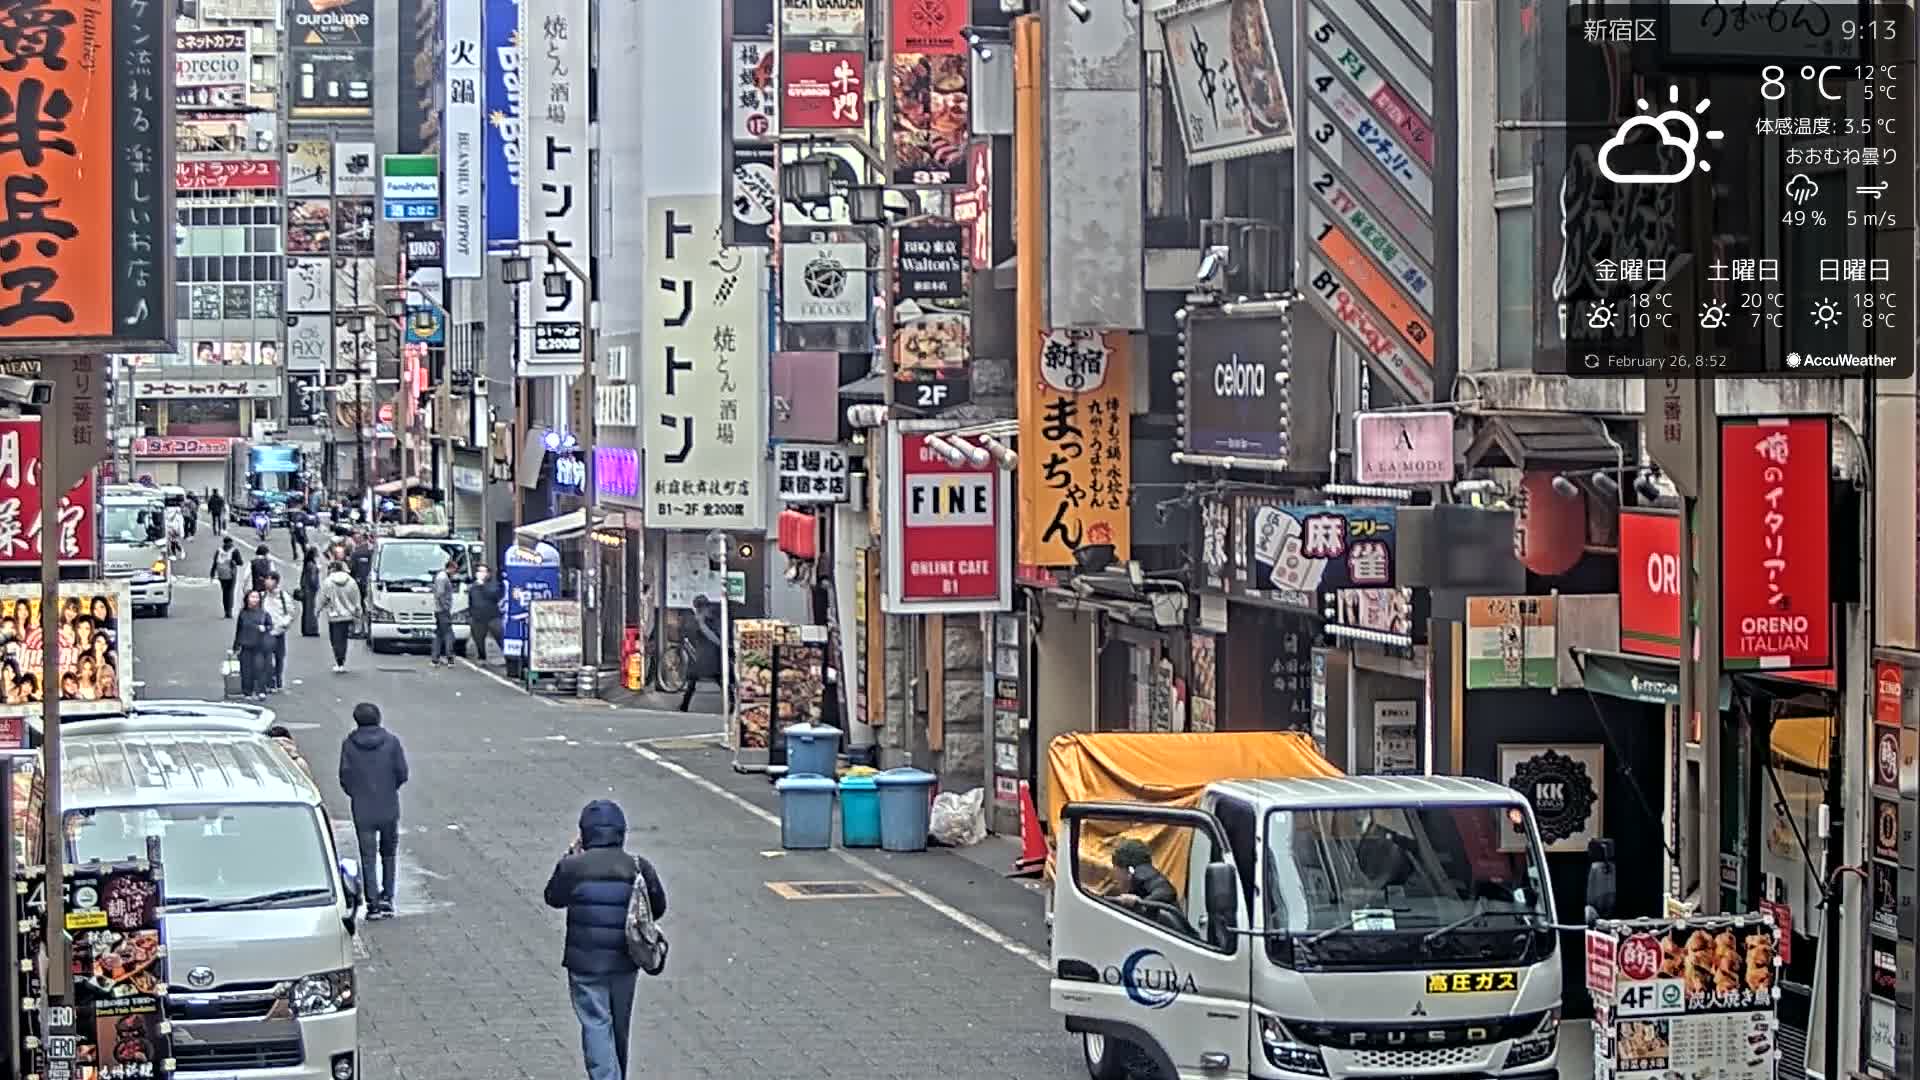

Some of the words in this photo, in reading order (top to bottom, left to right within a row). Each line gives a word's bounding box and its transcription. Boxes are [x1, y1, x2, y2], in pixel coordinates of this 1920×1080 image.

[1315, 23, 1335, 43] 5
[809, 41, 838, 53] 2F
[451, 39, 475, 104] 火鍋
[543, 15, 568, 124] 焼とん酒場
[831, 59, 860, 122] 牛門
[1315, 75, 1334, 93] 4
[1315, 123, 1335, 143] 3
[912, 170, 950, 184] 3F
[1314, 174, 1334, 194] 2
[1317, 224, 1333, 241] 1
[904, 241, 931, 253] BBQ
[902, 257, 960, 272] Walton's
[1313, 270, 1341, 299] B1
[660, 210, 693, 464] トントン
[1214, 353, 1265, 397] celona
[712, 325, 737, 445] 焼とん酒場
[918, 386, 948, 405] 2F
[780, 451, 844, 472] 酒場心
[1403, 461, 1446, 472] MODE
[1042, 397, 1087, 549] まっちゃん
[655, 479, 749, 496] 新宿歌舞伎町店
[779, 475, 844, 494] 新宿本店
[912, 485, 987, 514] FINE
[1350, 519, 1391, 535] フリー
[1755, 431, 1789, 605] 俺のイタリアン
[911, 561, 954, 576] ONLINE
[959, 560, 989, 574] CAFE
[942, 579, 959, 594] B1
[1741, 616, 1808, 634] ORENO
[1740, 634, 1808, 652] ITALIAN
[1536, 783, 1564, 798] KK
[1103, 965, 1199, 993] OGURA
[1429, 974, 1515, 992] 高圧ガス
[1621, 986, 1653, 1009] 4F
[1688, 991, 1771, 1010] 炭火焼き鳥
[1350, 1027, 1487, 1046] FUSO
